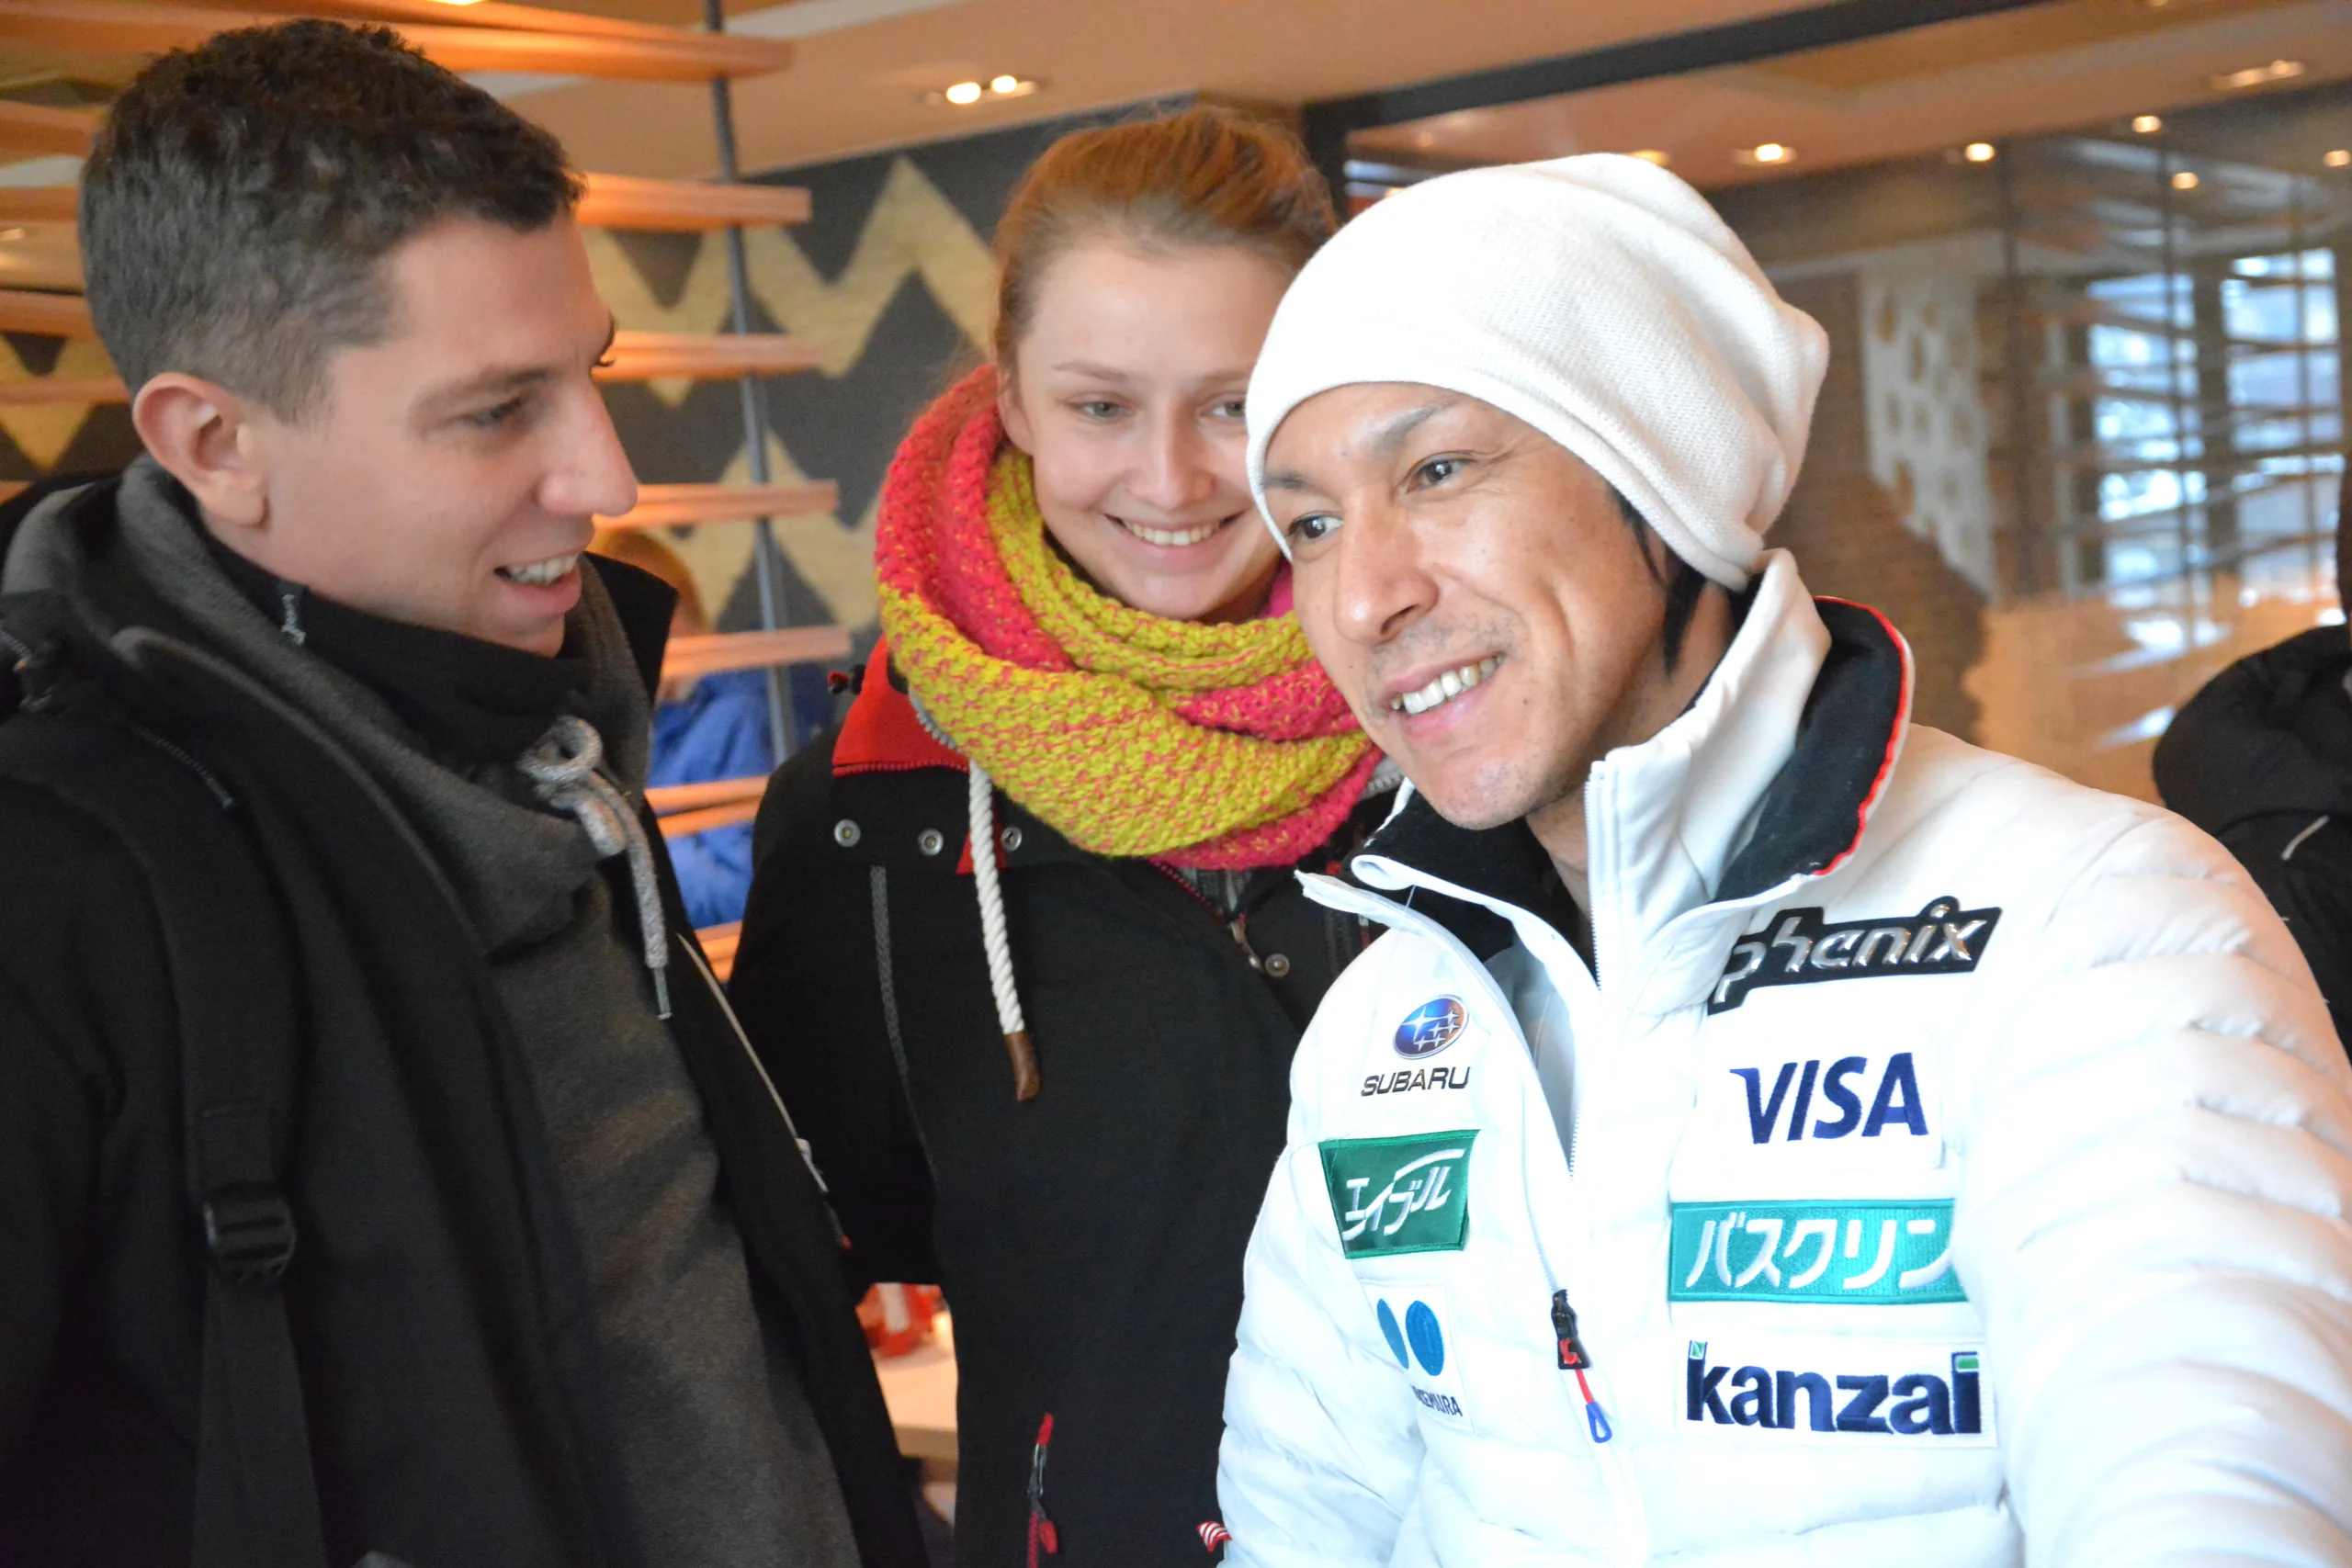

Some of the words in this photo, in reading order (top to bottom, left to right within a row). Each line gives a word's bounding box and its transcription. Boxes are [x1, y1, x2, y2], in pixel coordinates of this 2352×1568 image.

[1713, 901, 1988, 1005] phenix
[1361, 1066, 1470, 1097] SUBARU
[1729, 1052, 1929, 1145] VISA
[1341, 1147, 1467, 1241] エイブル
[1685, 1211, 1951, 1289] バスクリン
[1686, 1338, 1983, 1436] kanzai
